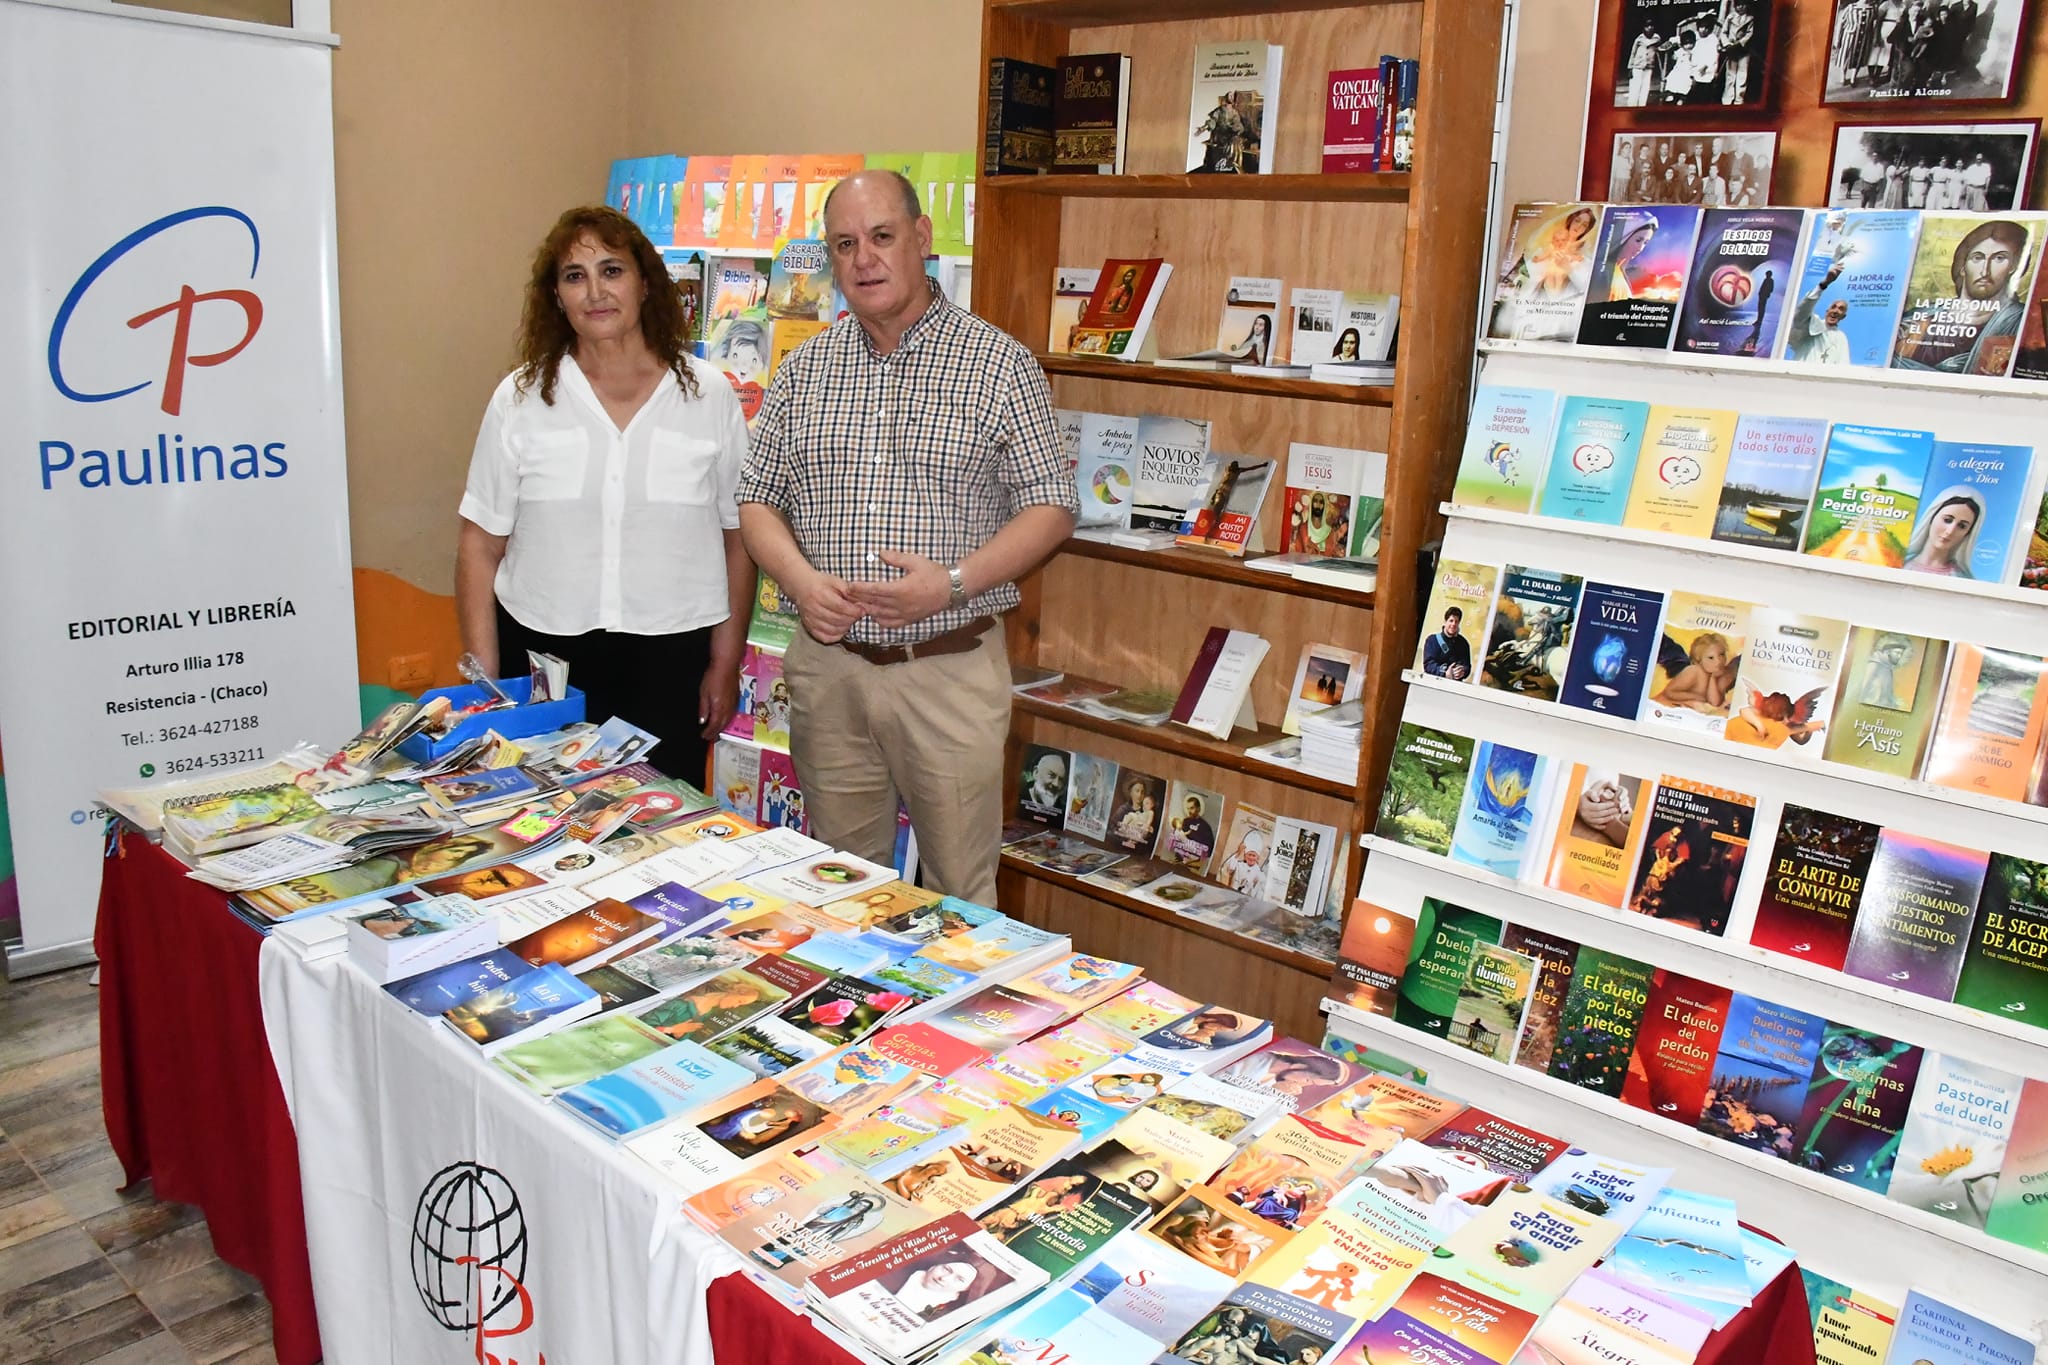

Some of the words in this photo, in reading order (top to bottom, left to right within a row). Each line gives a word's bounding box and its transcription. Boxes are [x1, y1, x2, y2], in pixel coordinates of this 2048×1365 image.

[1869, 88, 1911, 98] Familia
[1915, 87, 1952, 96] Alonso
[1351, 111, 1359, 125] II
[1723, 230, 1772, 241] TESTIGOS
[784, 243, 825, 255] SAGRADA
[1720, 244, 1734, 254] DE
[1735, 244, 1748, 255] LA
[1749, 244, 1769, 254] LUZ
[783, 255, 823, 271] BIBLIA
[724, 269, 750, 284] Biblia
[1915, 298, 1930, 308] LA
[1934, 298, 2001, 312] PERSONA
[1913, 311, 1928, 321] DE
[1910, 324, 1921, 335] EL
[1927, 323, 1977, 338] CRISTO
[1746, 430, 1761, 440] Un
[1766, 432, 1814, 444] estímulo
[1143, 445, 1200, 466] NOVIOS
[1738, 442, 1768, 453] todos
[1773, 443, 1788, 453] los
[1793, 444, 1817, 455] días
[39, 433, 288, 490] Paulinas
[1142, 460, 1200, 477] INQUIETOS
[1958, 457, 2005, 472] alegría
[1140, 471, 1155, 482] EN
[1156, 472, 1199, 487] CAMINO
[1304, 466, 1333, 480] JESÚS
[1975, 474, 1999, 485] Dios
[1842, 488, 1856, 500] El
[1860, 491, 1894, 505] Gran
[1822, 499, 1909, 520] Perdonador
[1219, 521, 1244, 533] CRISTO
[1236, 516, 1247, 525] MI
[1220, 531, 1241, 542] ROTO
[1521, 579, 1530, 587] EL
[1531, 580, 1561, 592] DIABLO
[68, 612, 183, 640] EDITORIAL
[188, 610, 201, 627] Y
[207, 597, 296, 625] LIBRERÍA
[1600, 605, 1637, 625] VIDA
[1695, 616, 1736, 630] amor
[1751, 649, 1772, 660] LOS
[1755, 638, 1767, 648] LA
[1817, 649, 1833, 660] DE
[126, 659, 179, 678] Arturo
[183, 656, 212, 671] Illia
[216, 652, 245, 667] 178
[106, 690, 196, 715] Resistencia
[211, 681, 268, 704] (Chaco)
[121, 730, 154, 747] Tel.:
[159, 715, 259, 742] 3624-427188
[1854, 719, 1903, 738] Hermano
[1416, 736, 1455, 753] FELICIDAD,
[1858, 733, 1901, 756] Asís
[166, 748, 264, 774] 3624-533211
[1569, 851, 1620, 871] reconciliados
[1605, 848, 1622, 860] Vivir
[1778, 859, 1796, 874] EL
[1798, 865, 1836, 885] ARTE
[1842, 875, 1861, 892] DE
[654, 892, 689, 912] Rescatar
[1778, 878, 1852, 909] CONVIVIR
[585, 909, 629, 932] Necesidad
[1986, 912, 2005, 930] EL
[1436, 931, 1470, 953] Duelo
[1982, 930, 2005, 948] DE
[1434, 949, 1456, 964] para
[1458, 954, 1467, 966] la
[1484, 957, 1495, 969] La
[1497, 962, 1516, 976] vida
[480, 958, 511, 982] Padres
[1358, 967, 1371, 977] PASA
[1372, 970, 1397, 985] DESPUÉS
[1476, 966, 1517, 989] ilumina
[1347, 972, 1354, 980] DE
[1356, 974, 1363, 982] LA
[1364, 976, 1389, 990] MUERTE?
[1583, 975, 1600, 990] El
[1602, 980, 1647, 1005] duelo
[1586, 997, 1609, 1014] por
[1612, 1003, 1633, 1020] los
[1663, 1004, 1678, 1021] El
[1681, 1011, 1719, 1033] duelo
[1583, 1013, 1632, 1039] nietos
[1678, 1028, 1696, 1041] del
[884, 1039, 902, 1052] por
[904, 1046, 915, 1056] tu
[892, 1033, 937, 1059] Gracias,
[1659, 1038, 1710, 1061] perdón
[878, 1044, 939, 1072] AMISTAD
[1839, 1060, 1905, 1093] Lágrimas
[1856, 1086, 1876, 1100] del
[1938, 1083, 2009, 1115] Pastoral
[1842, 1096, 1881, 1118] alma
[1934, 1101, 1955, 1116] del
[1959, 1106, 2003, 1129] duelo
[1475, 1124, 1485, 1133] la
[1488, 1130, 1547, 1158] comunión
[1486, 1120, 1536, 1144] Ministro
[1538, 1140, 1554, 1151] de
[1460, 1136, 1479, 1148] del
[1481, 1145, 1532, 1170] enfermo
[1483, 1137, 1494, 1146] al
[1496, 1142, 1539, 1164] servicio
[1571, 1171, 1583, 1180] ir
[1589, 1170, 1635, 1188] Saber
[1365, 1182, 1427, 1221] Devocionario
[1605, 1188, 1635, 1203] allá
[1025, 1211, 1087, 1252] Misericordia
[1357, 1201, 1401, 1231] Cuando
[1404, 1229, 1437, 1248] visite
[1362, 1219, 1377, 1229] un
[1513, 1212, 1583, 1245] construir
[1535, 1211, 1575, 1234] Para
[1322, 1220, 1354, 1242] PARA
[1356, 1241, 1372, 1252] MI
[1372, 1251, 1413, 1270] AMIGO
[1510, 1219, 1526, 1230] el
[1529, 1230, 1572, 1251] amor
[830, 1265, 856, 1282] Santa
[856, 1252, 890, 1270] Teresita
[891, 1244, 904, 1257] del
[904, 1234, 927, 1250] Niño
[927, 1226, 950, 1241] Jesús
[886, 1260, 893, 1269] y
[893, 1255, 903, 1265] de
[904, 1252, 913, 1262] la
[913, 1242, 938, 1257] Santa
[938, 1232, 959, 1248] Faz
[1334, 1238, 1388, 1270] ENFERMO
[1243, 1299, 1280, 1319] FIELES
[1281, 1310, 1334, 1337] DIFUNTOS
[1250, 1290, 1334, 1327] DEVOCIONARIO
[1914, 1303, 1967, 1332] CARDENAL
[1822, 1313, 1850, 1332] Amor
[1817, 1326, 1877, 1357] apasionado
[1912, 1315, 1961, 1342] EDUARDO
[1964, 1336, 1974, 1349] F.
[1979, 1342, 2023, 1365] PIRONIO
